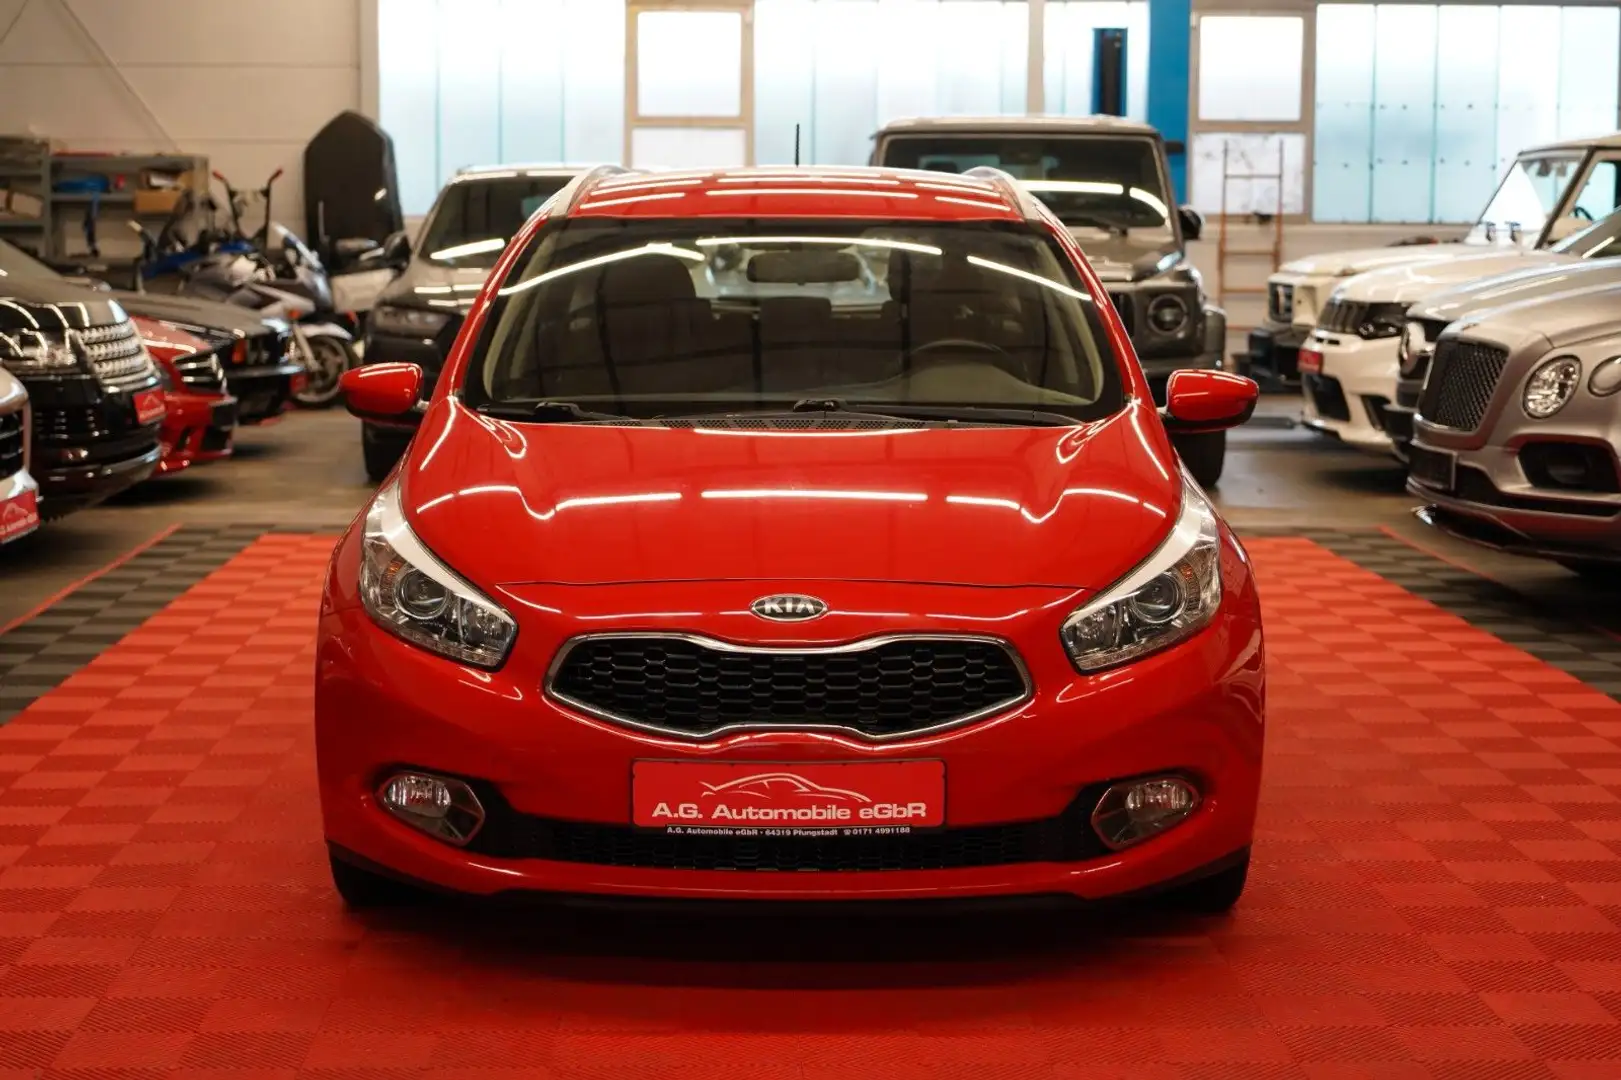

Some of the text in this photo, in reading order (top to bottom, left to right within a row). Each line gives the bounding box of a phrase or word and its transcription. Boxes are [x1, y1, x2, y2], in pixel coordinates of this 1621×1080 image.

[765, 597, 815, 614] KIA
[652, 802, 926, 820] A.G. Automobile eGbR
[667, 826, 684, 834] A.G.
[686, 827, 733, 835] Automobile
[735, 828, 758, 836] eGbR
[765, 828, 791, 836] 64319
